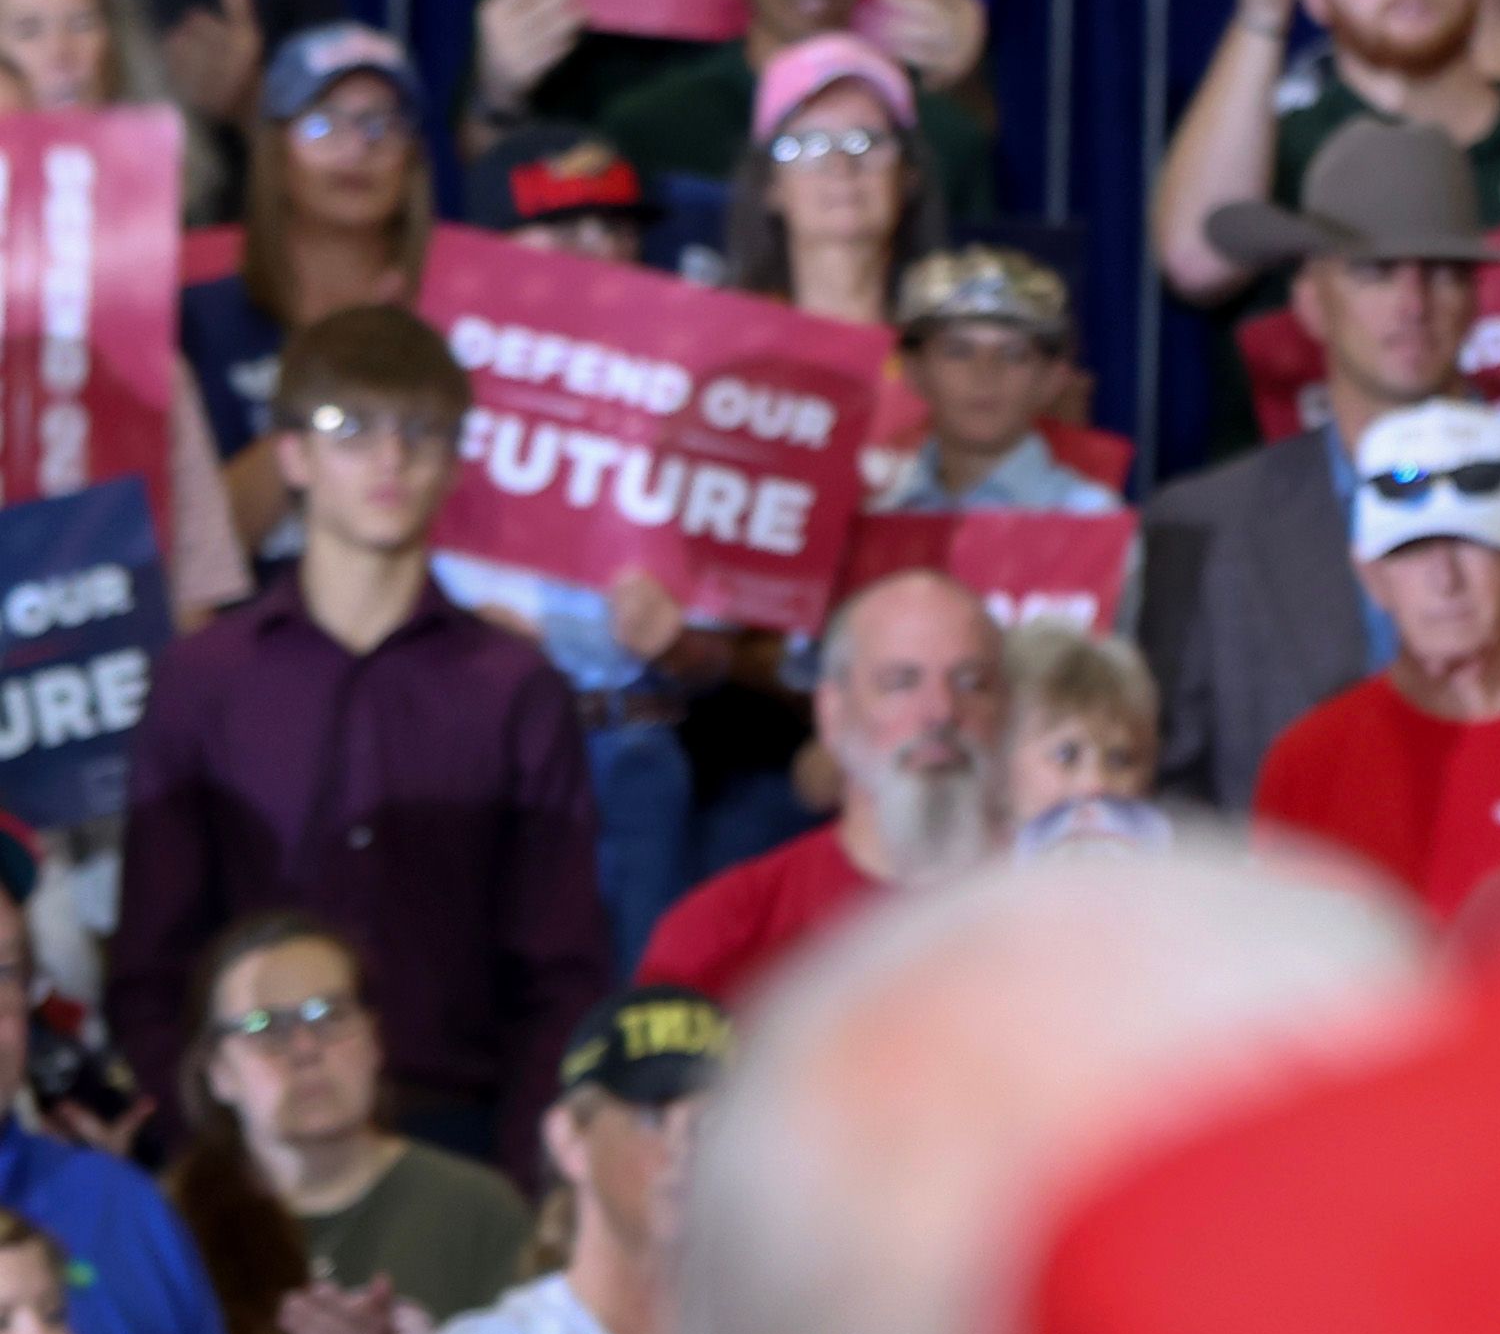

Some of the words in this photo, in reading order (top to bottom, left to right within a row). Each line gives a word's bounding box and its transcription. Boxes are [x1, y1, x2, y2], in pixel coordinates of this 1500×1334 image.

[448, 315, 692, 416] DEFEND
[701, 376, 835, 450] OUR
[4, 563, 134, 639] OUR
